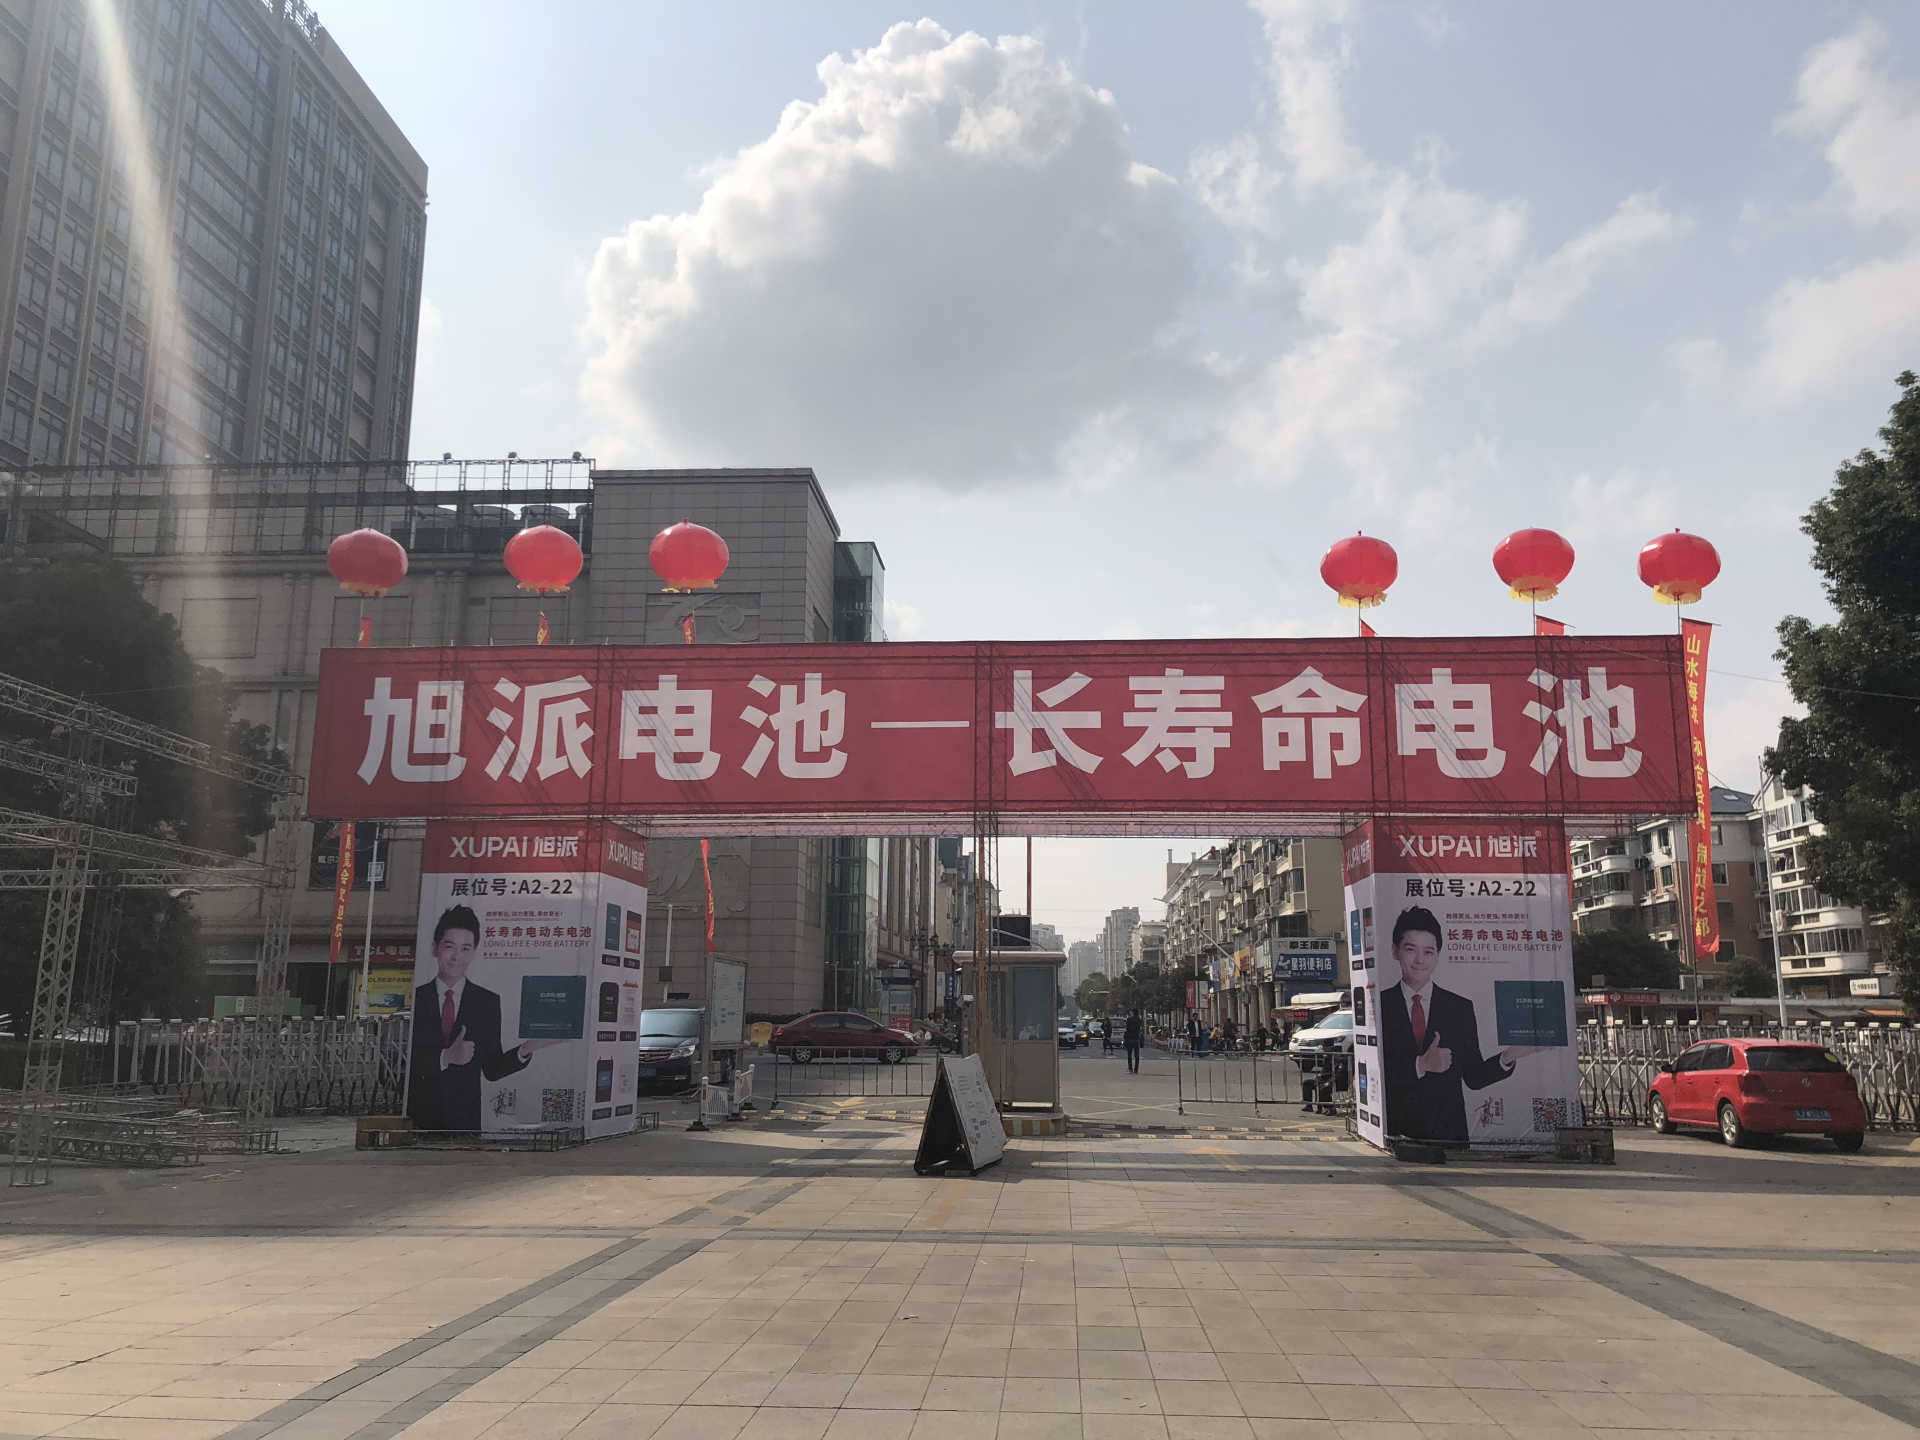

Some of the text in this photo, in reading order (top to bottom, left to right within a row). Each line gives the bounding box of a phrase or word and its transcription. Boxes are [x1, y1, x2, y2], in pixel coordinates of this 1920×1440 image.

[449, 836, 579, 858] XUPAI 旭派
[608, 840, 631, 867] XUPAI
[1399, 835, 1537, 858] XUPAI 旭派
[485, 926, 592, 938] 长寿命电动车电池
[1447, 928, 1564, 942] 长寿命电动车电池
[1447, 943, 1472, 951] LONG
[1474, 943, 1491, 951] LIFE
[1524, 943, 1562, 952] BATTERY
